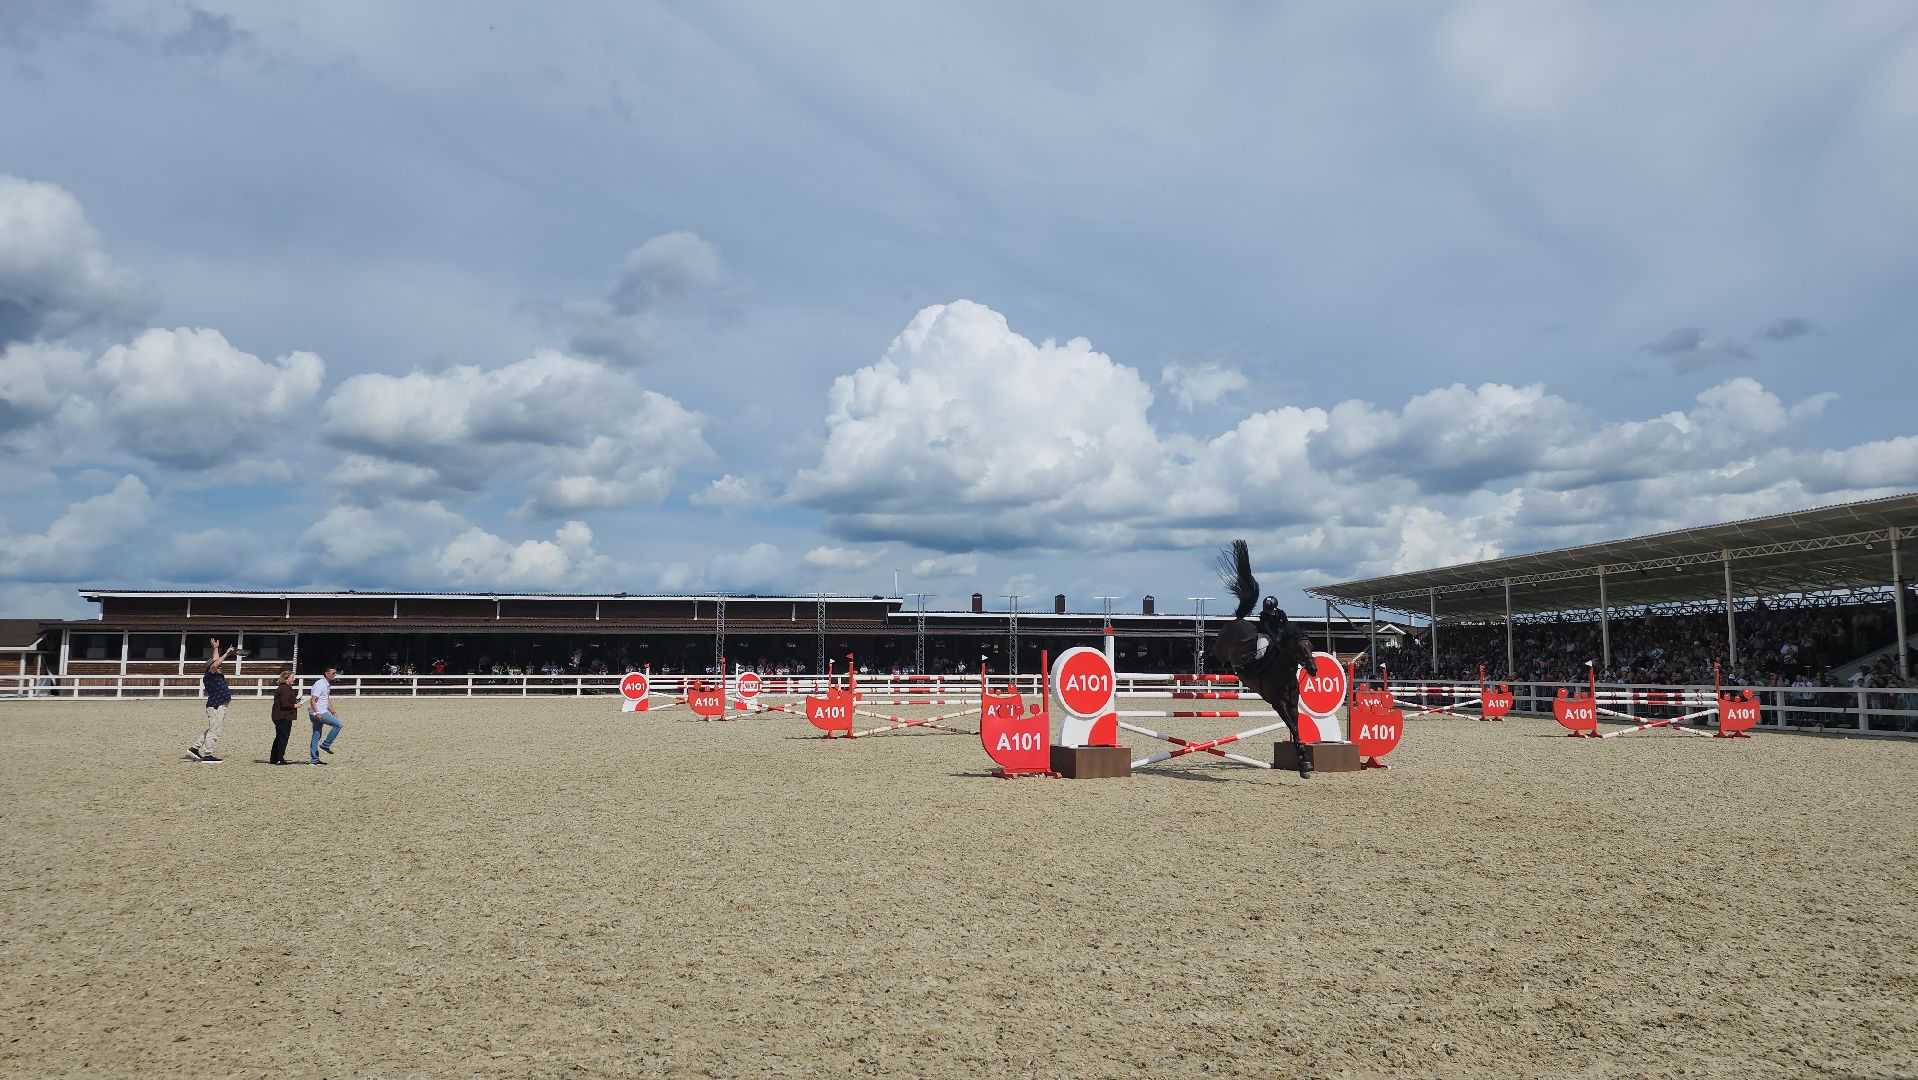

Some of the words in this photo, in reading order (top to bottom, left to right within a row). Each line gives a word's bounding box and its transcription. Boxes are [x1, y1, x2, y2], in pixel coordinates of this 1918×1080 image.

[625, 683, 645, 691] A101
[1066, 674, 1108, 692] A101
[1304, 676, 1340, 694] A101
[695, 697, 720, 707] A101
[1488, 699, 1510, 708] A101
[814, 706, 845, 719] A101
[1564, 708, 1593, 721] A101
[1727, 708, 1755, 720] A101
[1359, 724, 1395, 741] A101
[996, 732, 1041, 751] A101
